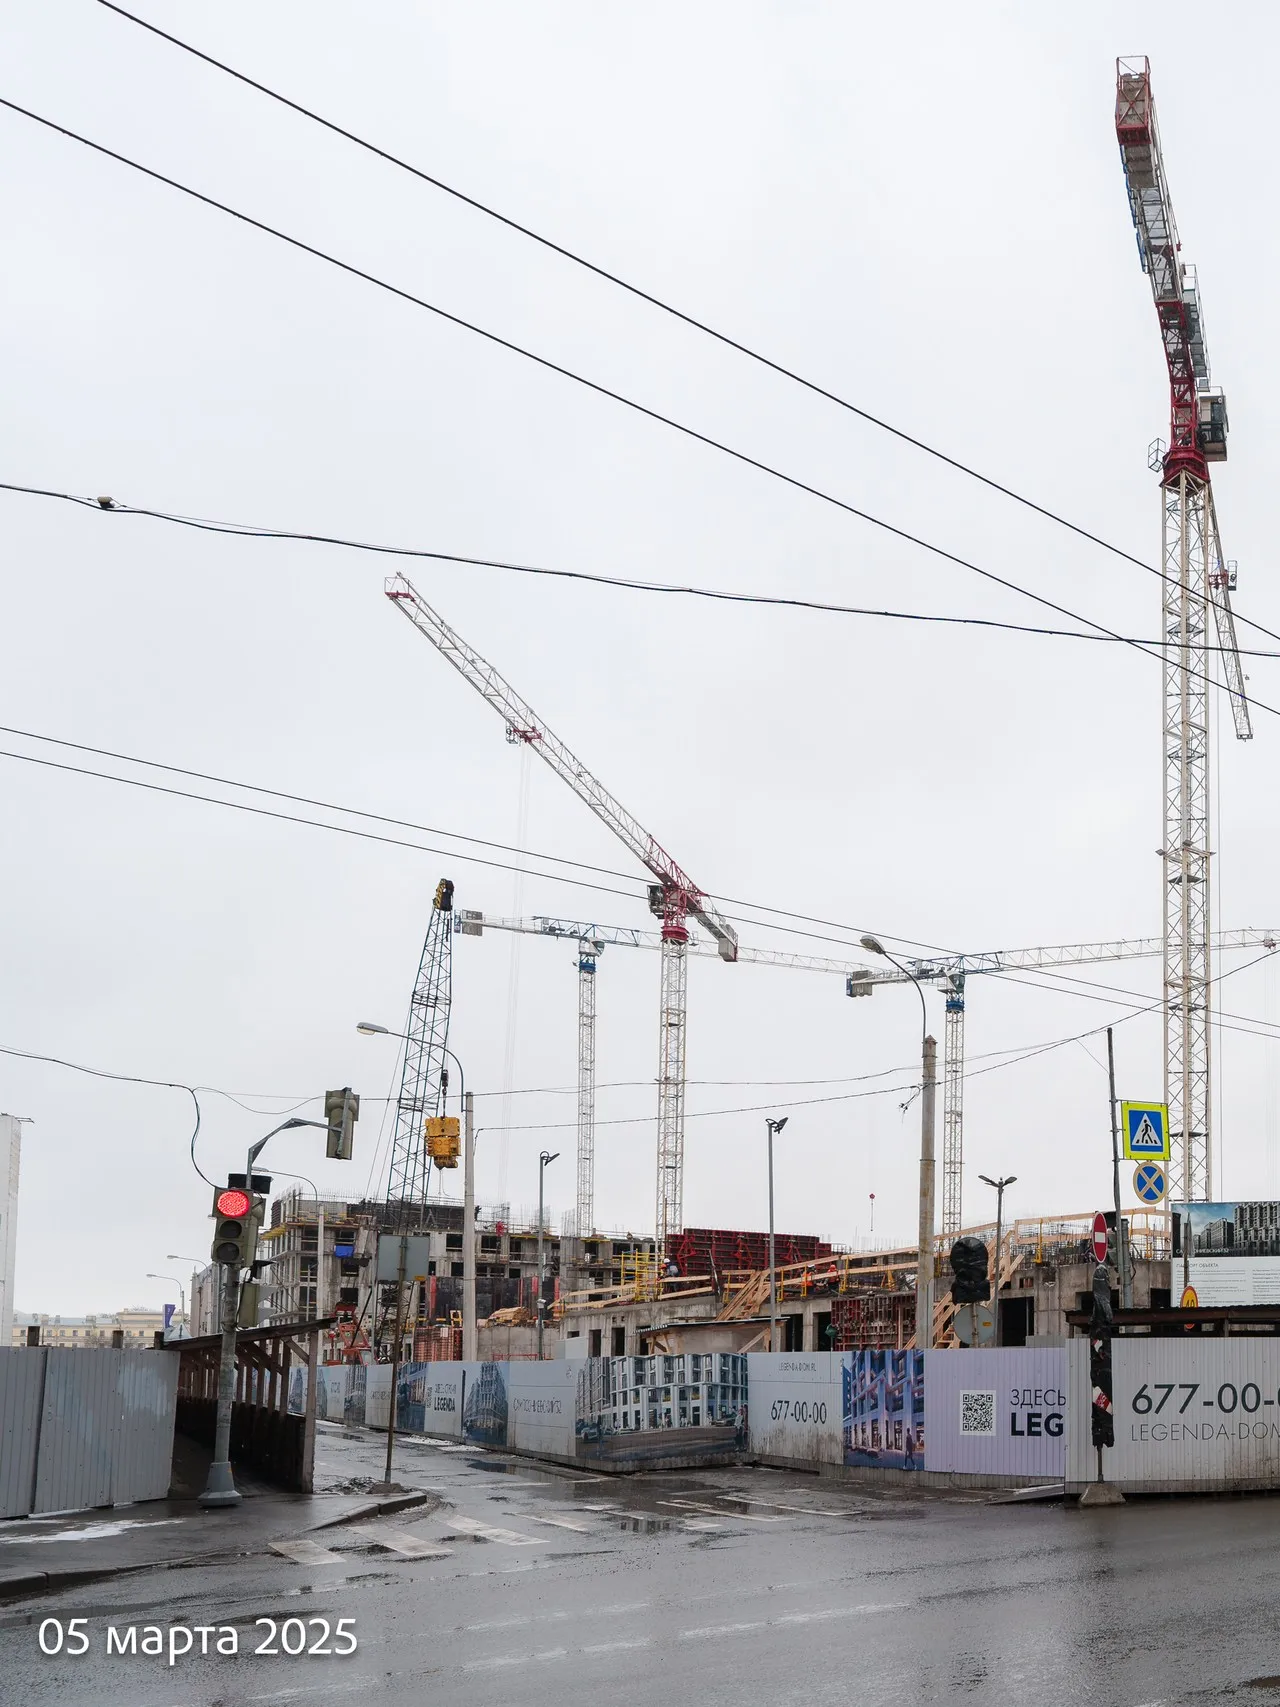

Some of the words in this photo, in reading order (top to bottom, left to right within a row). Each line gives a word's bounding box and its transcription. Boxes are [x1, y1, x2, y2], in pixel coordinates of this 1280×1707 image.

[1010, 1389, 1067, 1409] ЗДЕСЬ
[771, 1400, 827, 1424] 677-00-00
[1011, 1412, 1064, 1437] LEG
